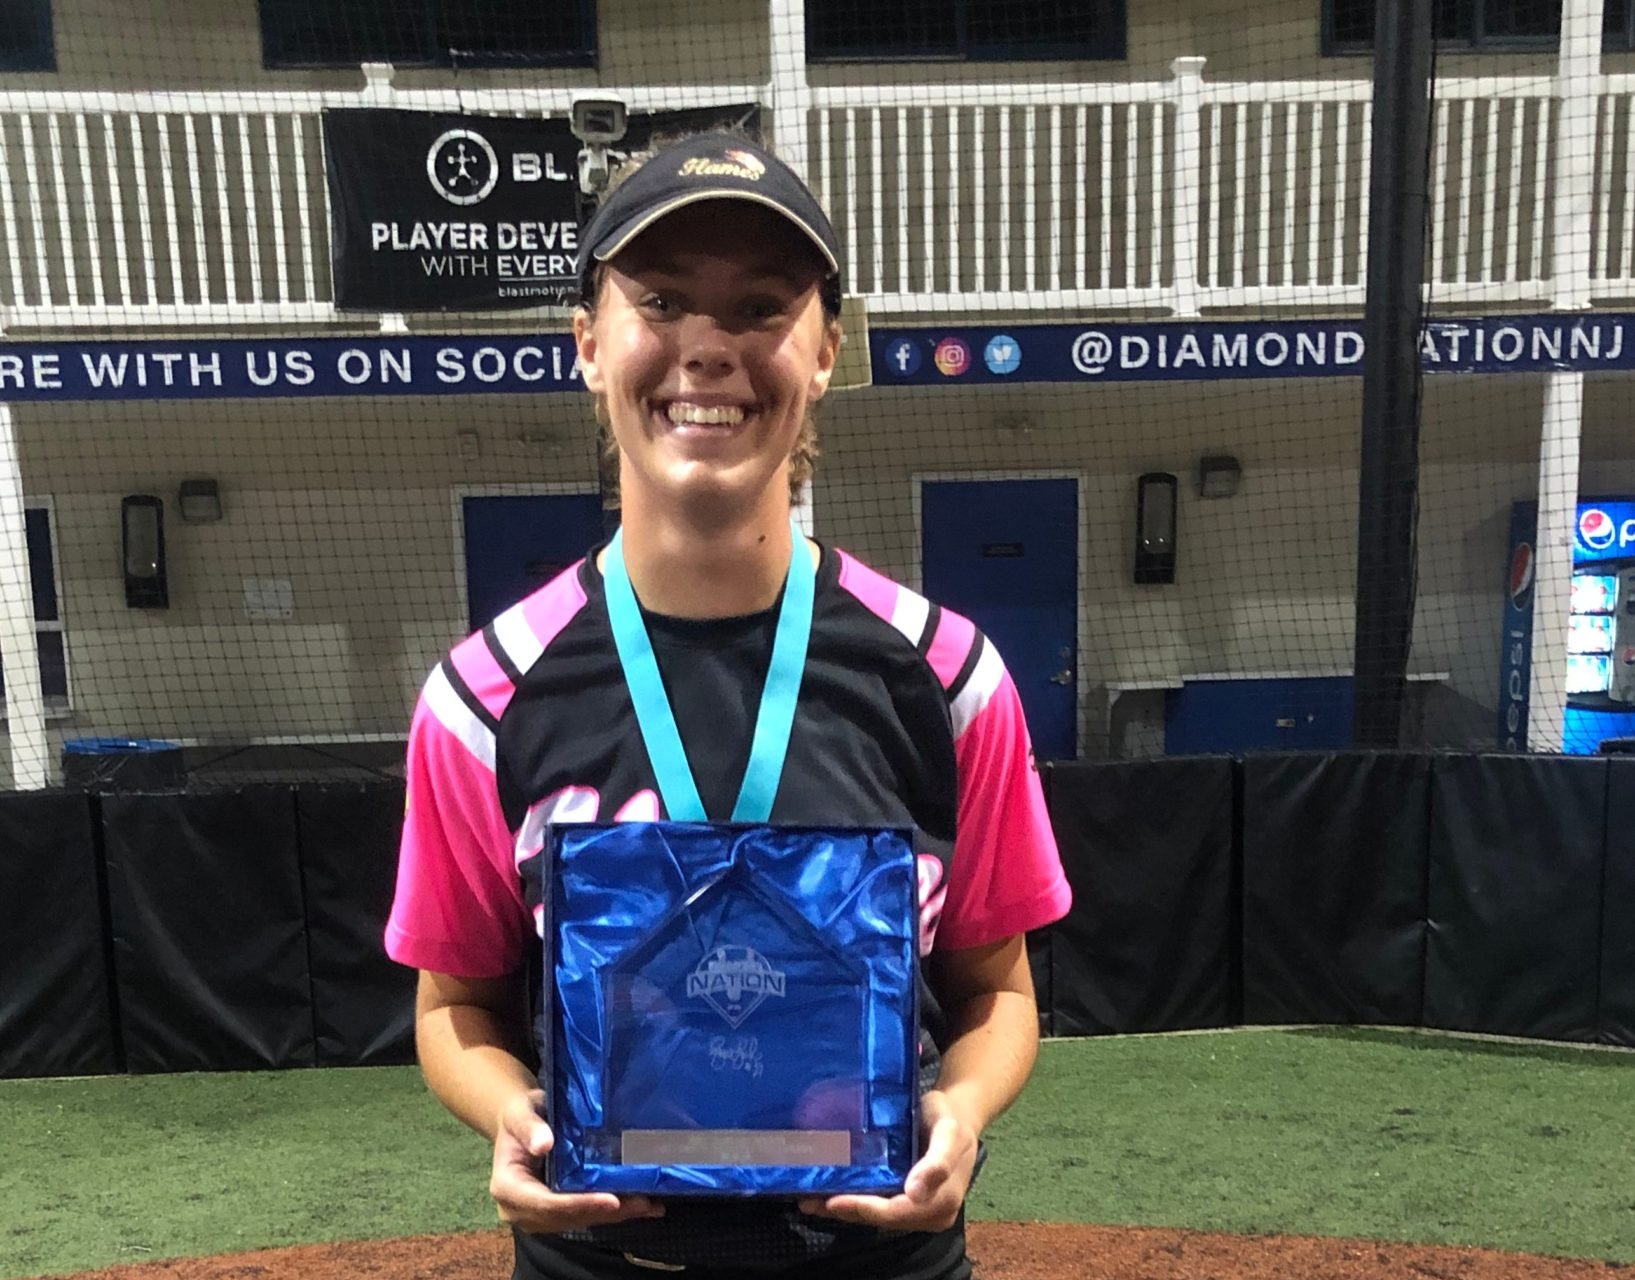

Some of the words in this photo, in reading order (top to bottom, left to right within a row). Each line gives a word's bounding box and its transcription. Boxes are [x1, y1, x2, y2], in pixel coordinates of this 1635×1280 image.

[512, 152, 574, 182] BL
[371, 222, 489, 251] PLAYER
[497, 222, 578, 250] DEVE
[421, 255, 489, 277] WITH
[497, 254, 580, 276] EVERY
[1071, 325, 1624, 375] @DIAMONDATIONNJ
[82, 352, 222, 389] WITH
[246, 350, 316, 387] US
[337, 348, 412, 385] ON
[689, 971, 783, 996] NATION
